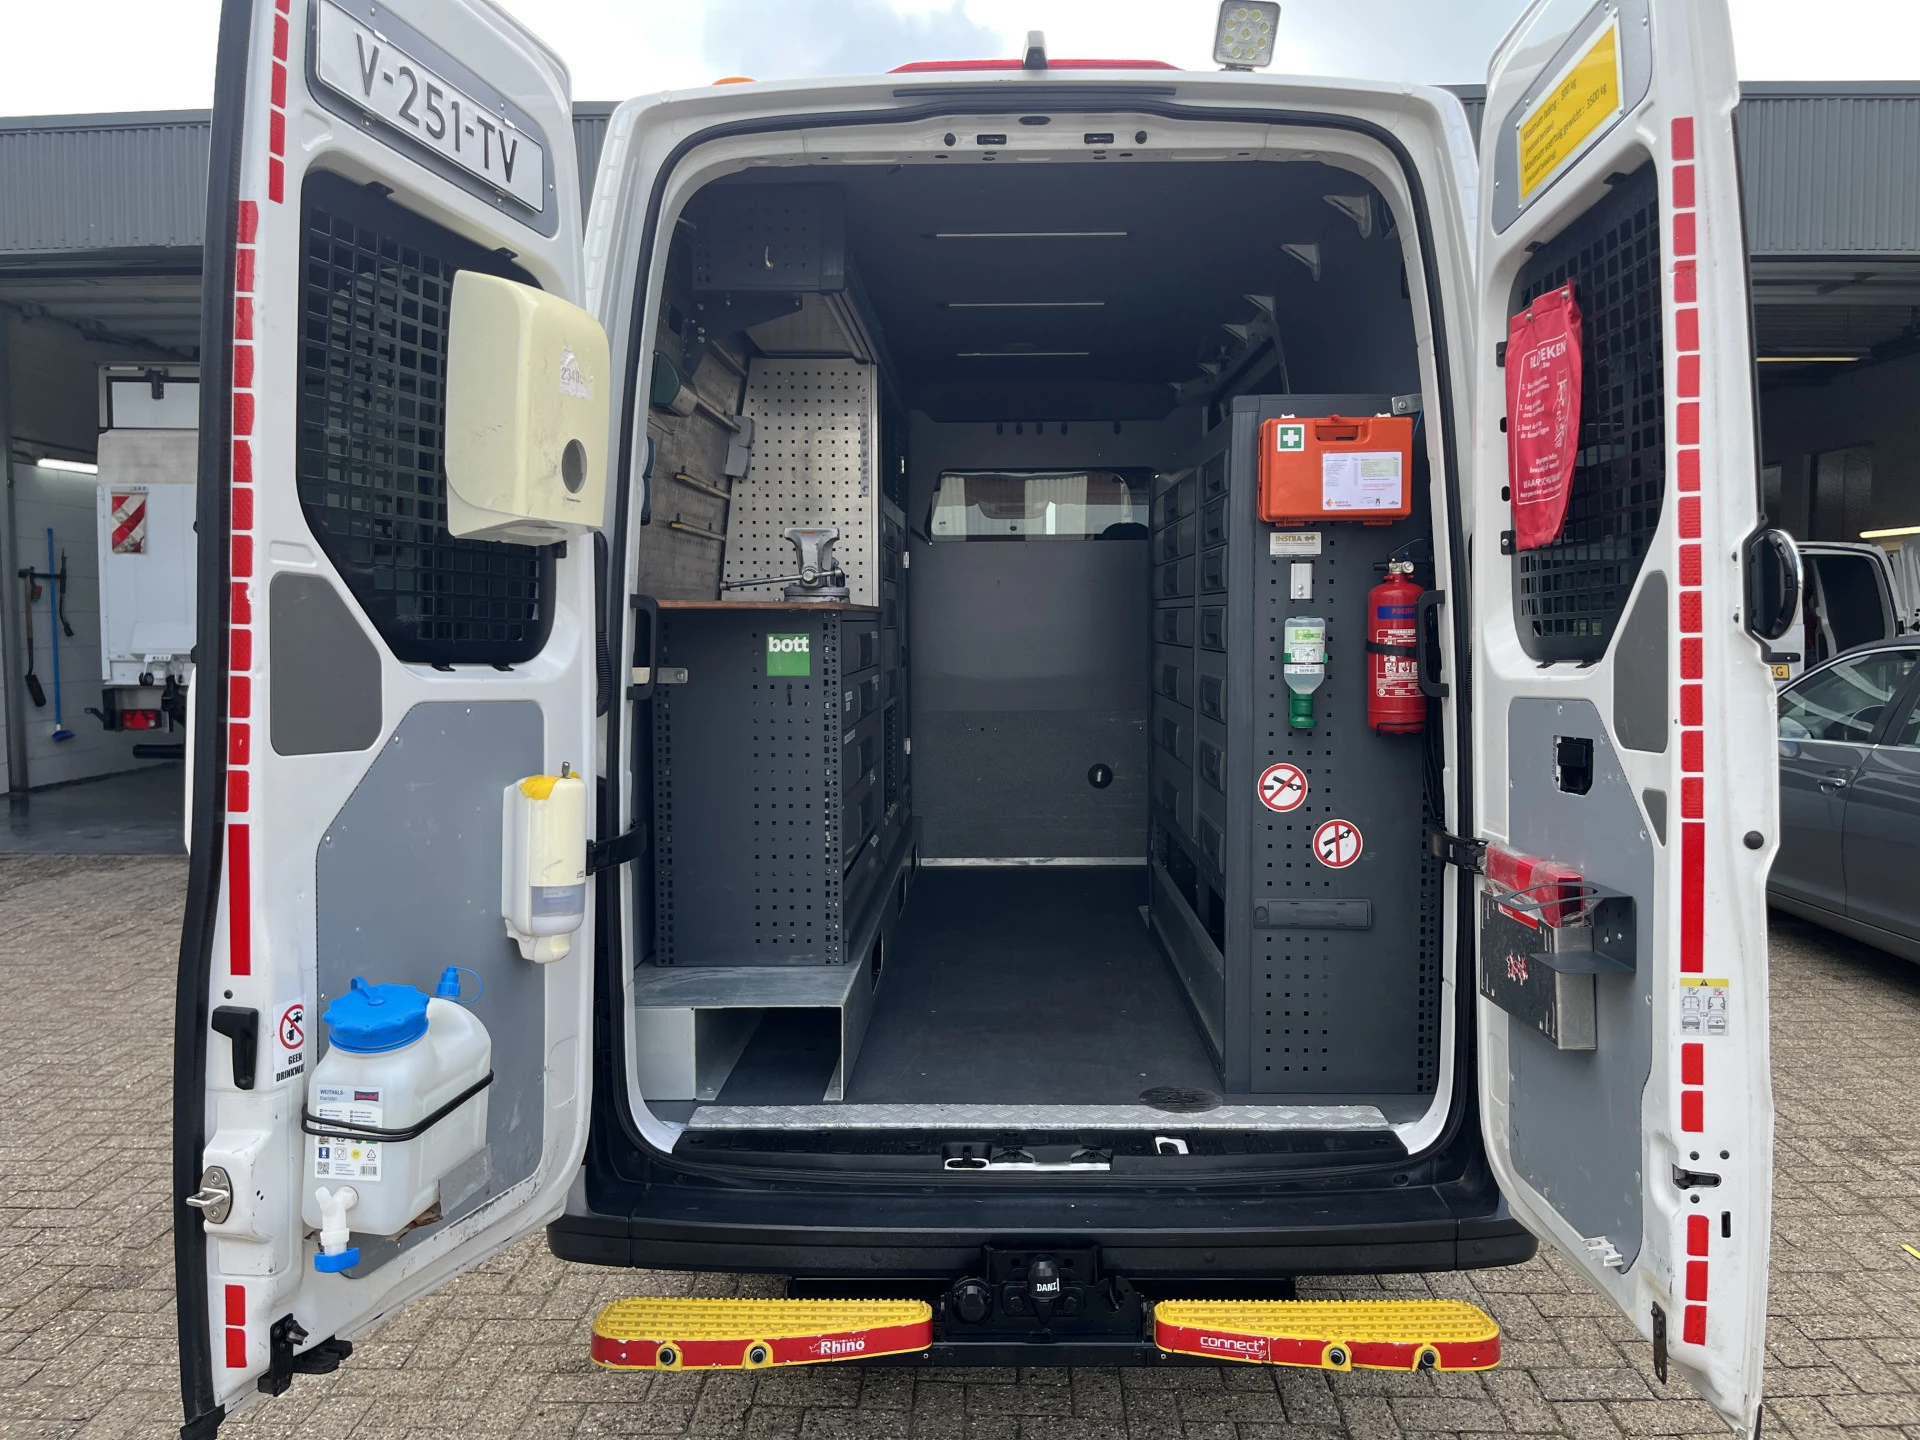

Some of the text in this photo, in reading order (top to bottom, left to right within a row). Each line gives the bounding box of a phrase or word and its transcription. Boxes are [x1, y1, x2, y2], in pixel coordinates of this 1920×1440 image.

[356, 33, 518, 183] V-251-TV
[1523, 115, 1543, 141] Maximum
[1570, 79, 1577, 90] kg
[1524, 148, 1544, 173] Maximum
[1586, 88, 1600, 109] 3500
[1600, 83, 1607, 95] kg
[768, 636, 810, 653] bott
[288, 1051, 303, 1065] GEEN
[820, 1340, 865, 1355] Rhino
